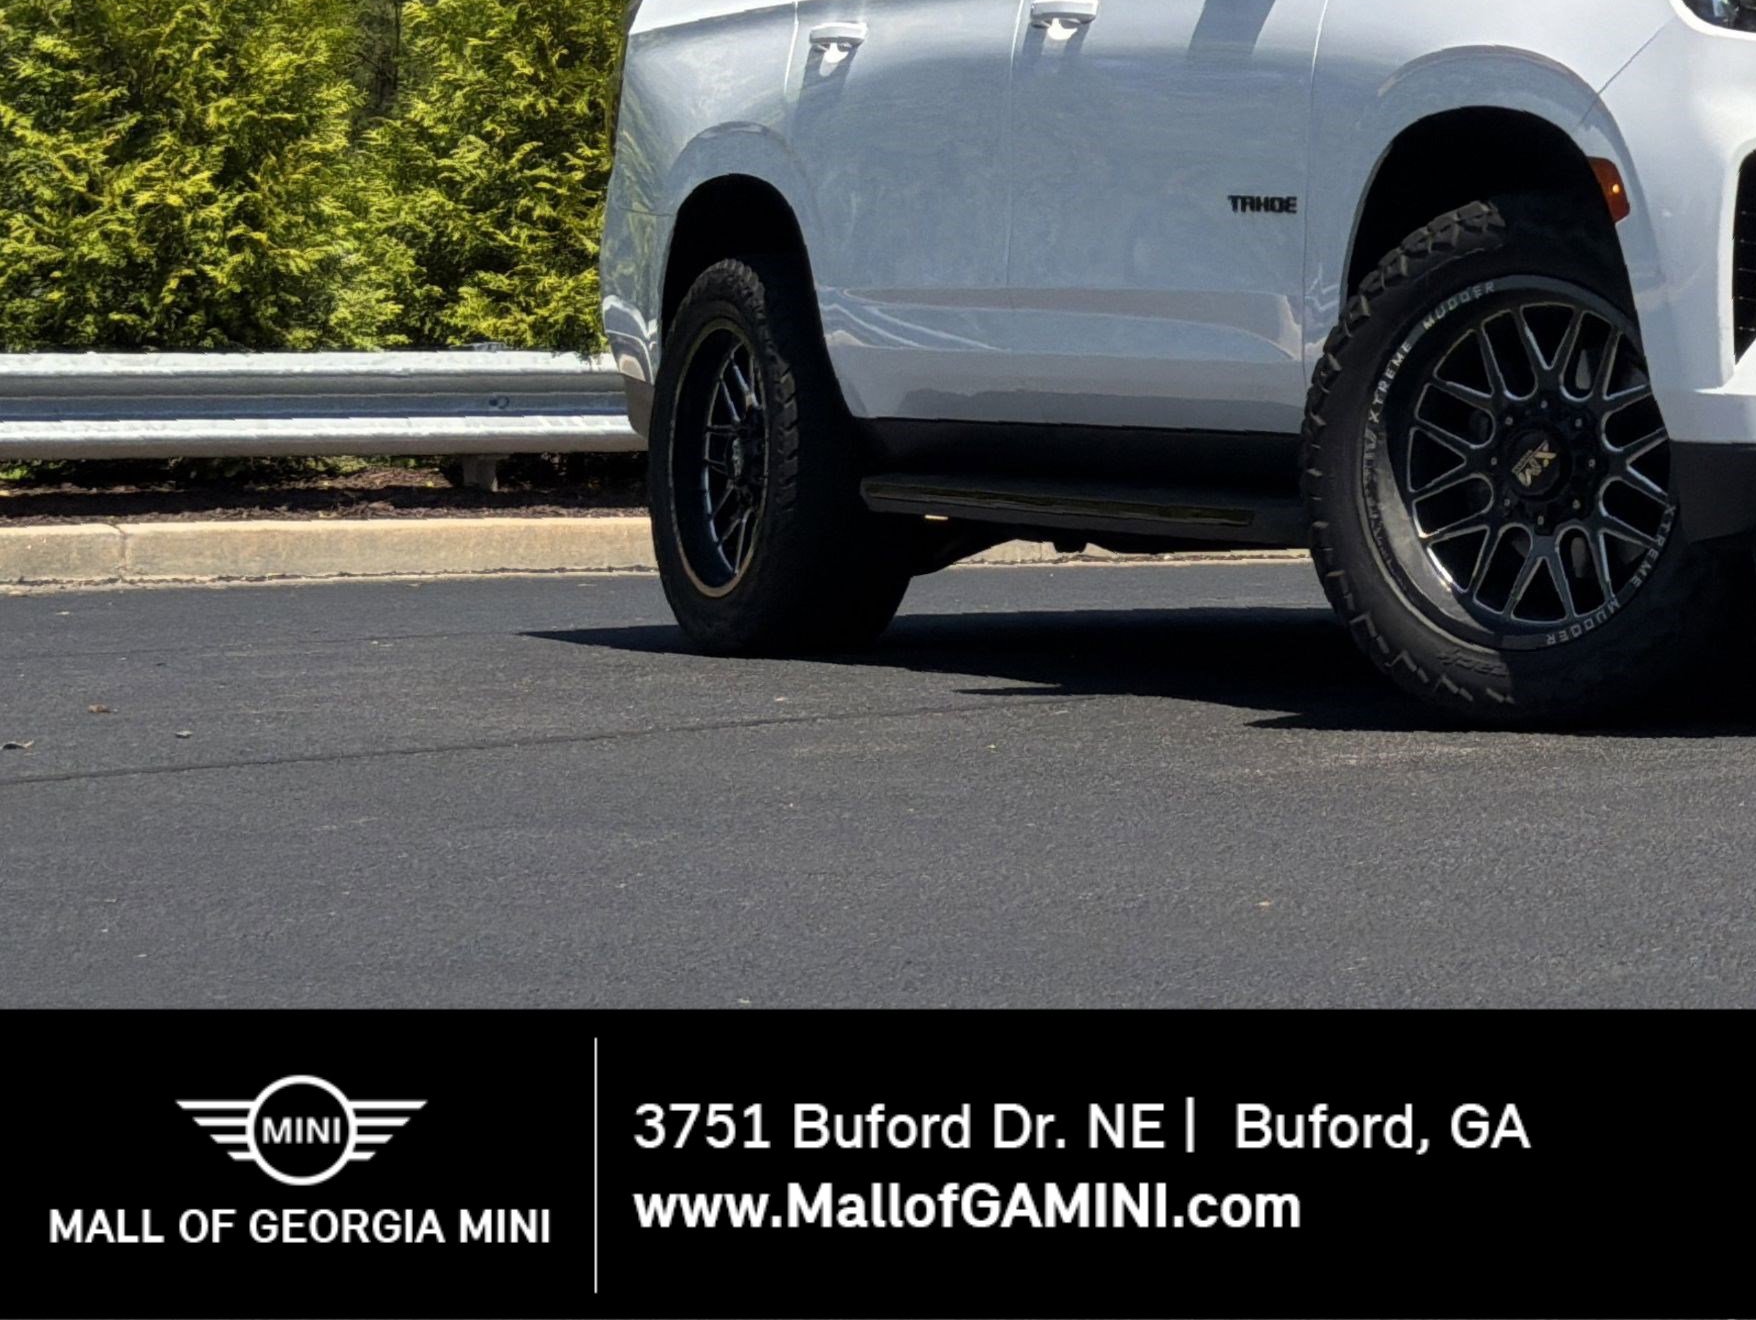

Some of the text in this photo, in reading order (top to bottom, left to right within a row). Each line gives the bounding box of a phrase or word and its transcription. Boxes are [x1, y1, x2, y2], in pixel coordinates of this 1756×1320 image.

[1227, 195, 1298, 214] TAHOE
[1368, 281, 1495, 424] XTREME MUDDER
[1630, 504, 1677, 588] XTREME
